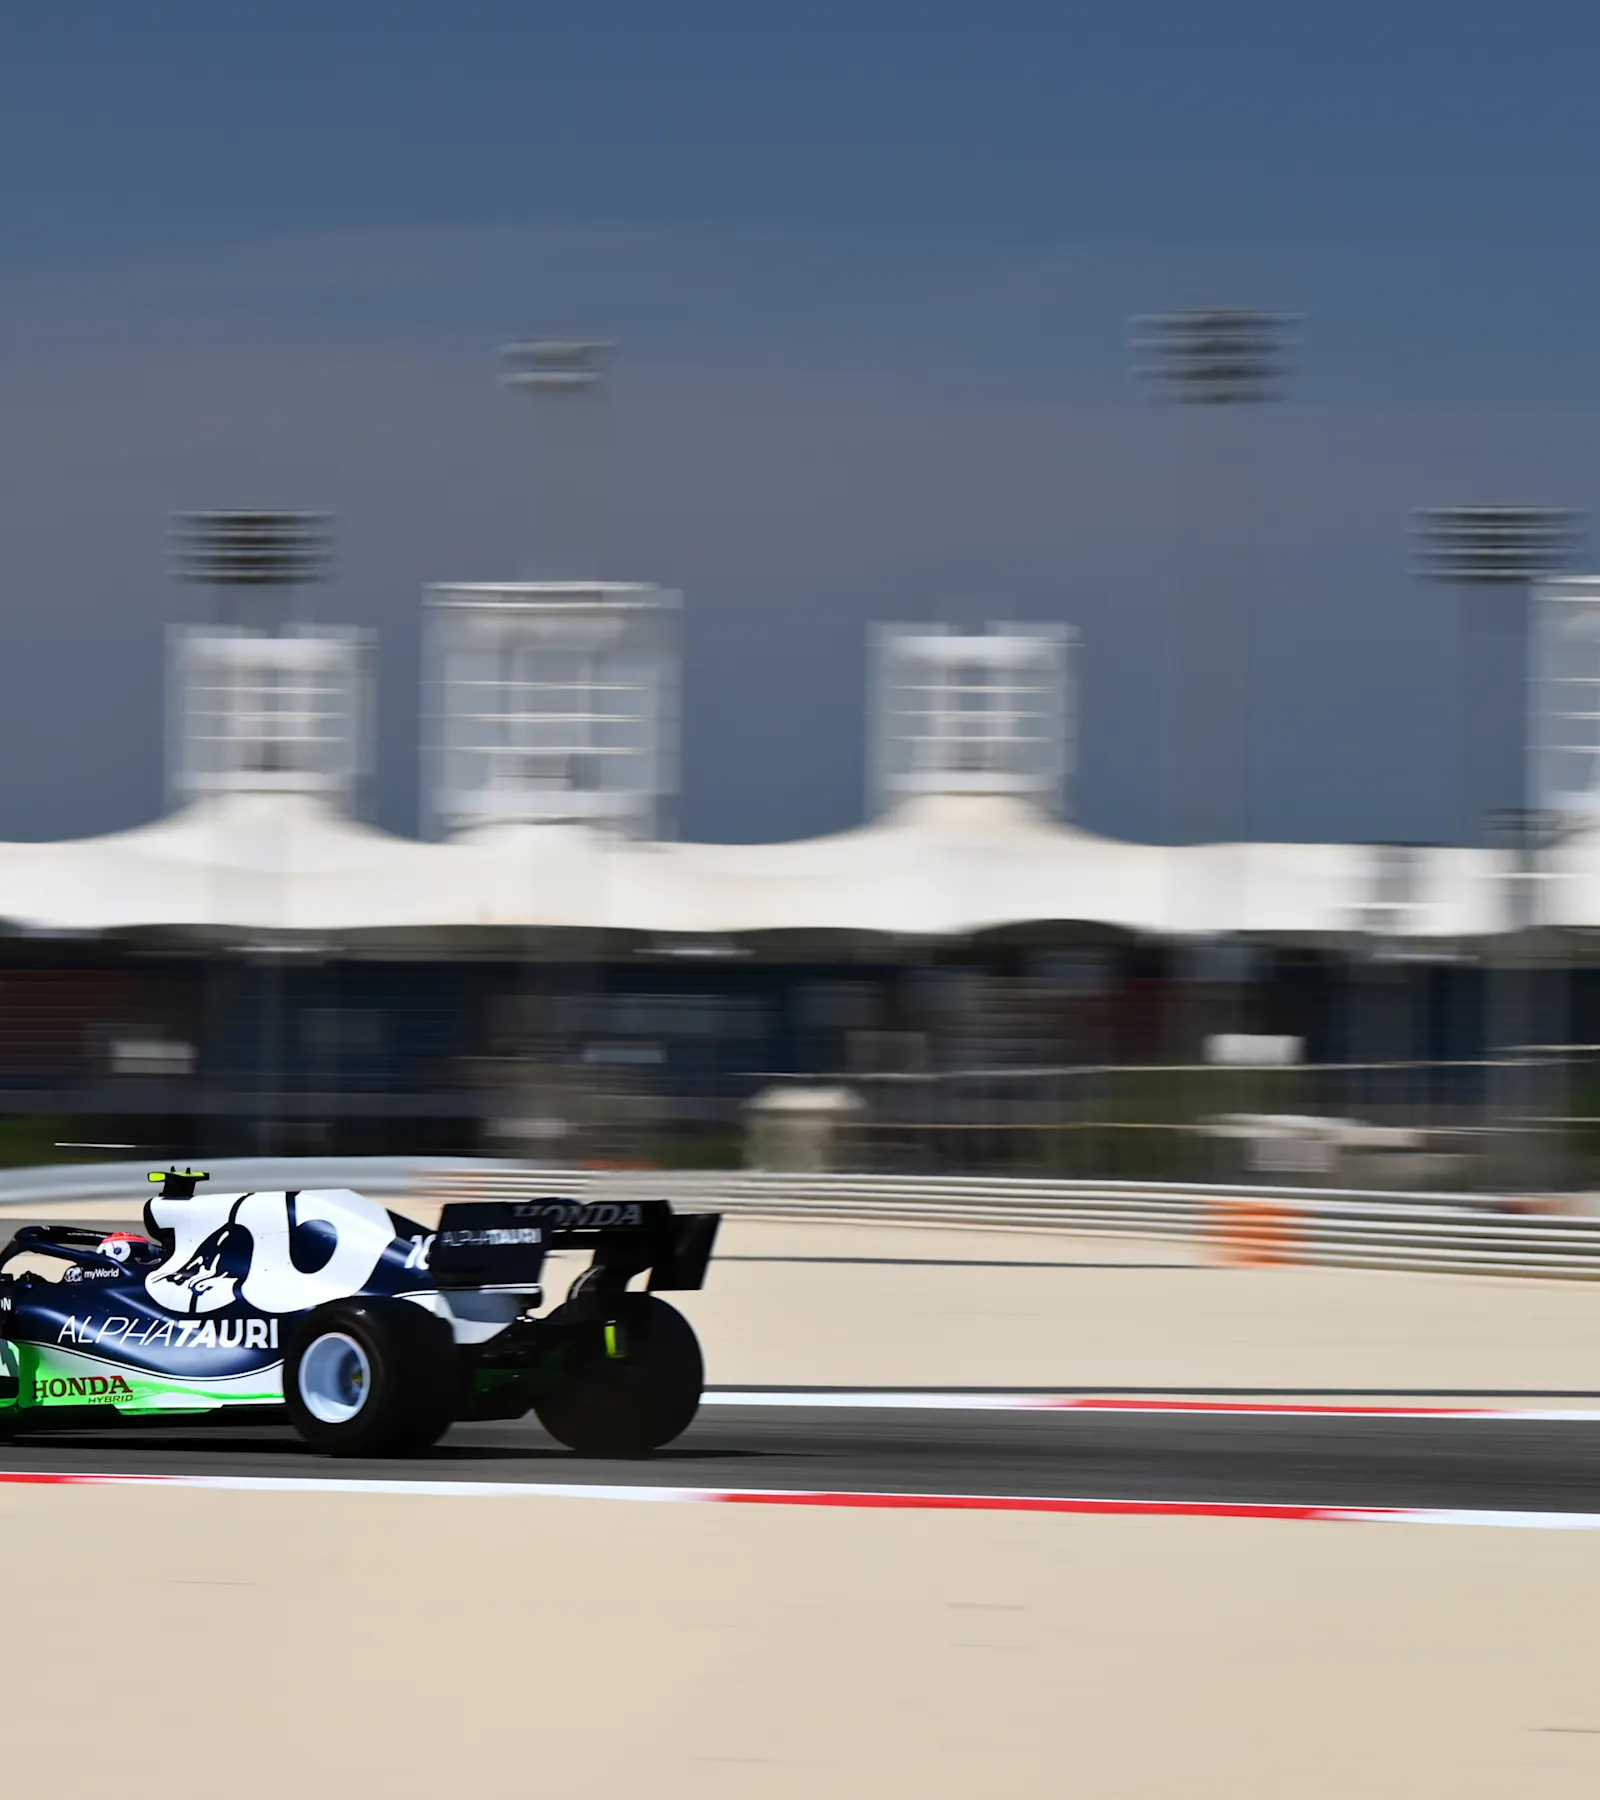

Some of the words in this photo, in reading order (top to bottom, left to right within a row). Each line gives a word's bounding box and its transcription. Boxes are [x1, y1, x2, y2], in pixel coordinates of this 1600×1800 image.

[513, 1203, 644, 1227] HONDA
[441, 1228, 542, 1247] ALPHATAURI
[84, 1268, 119, 1279] myWorld
[57, 1314, 279, 1349] ALPHATAURI
[32, 1375, 133, 1400] HONDA
[87, 1394, 133, 1404] HYBRID
